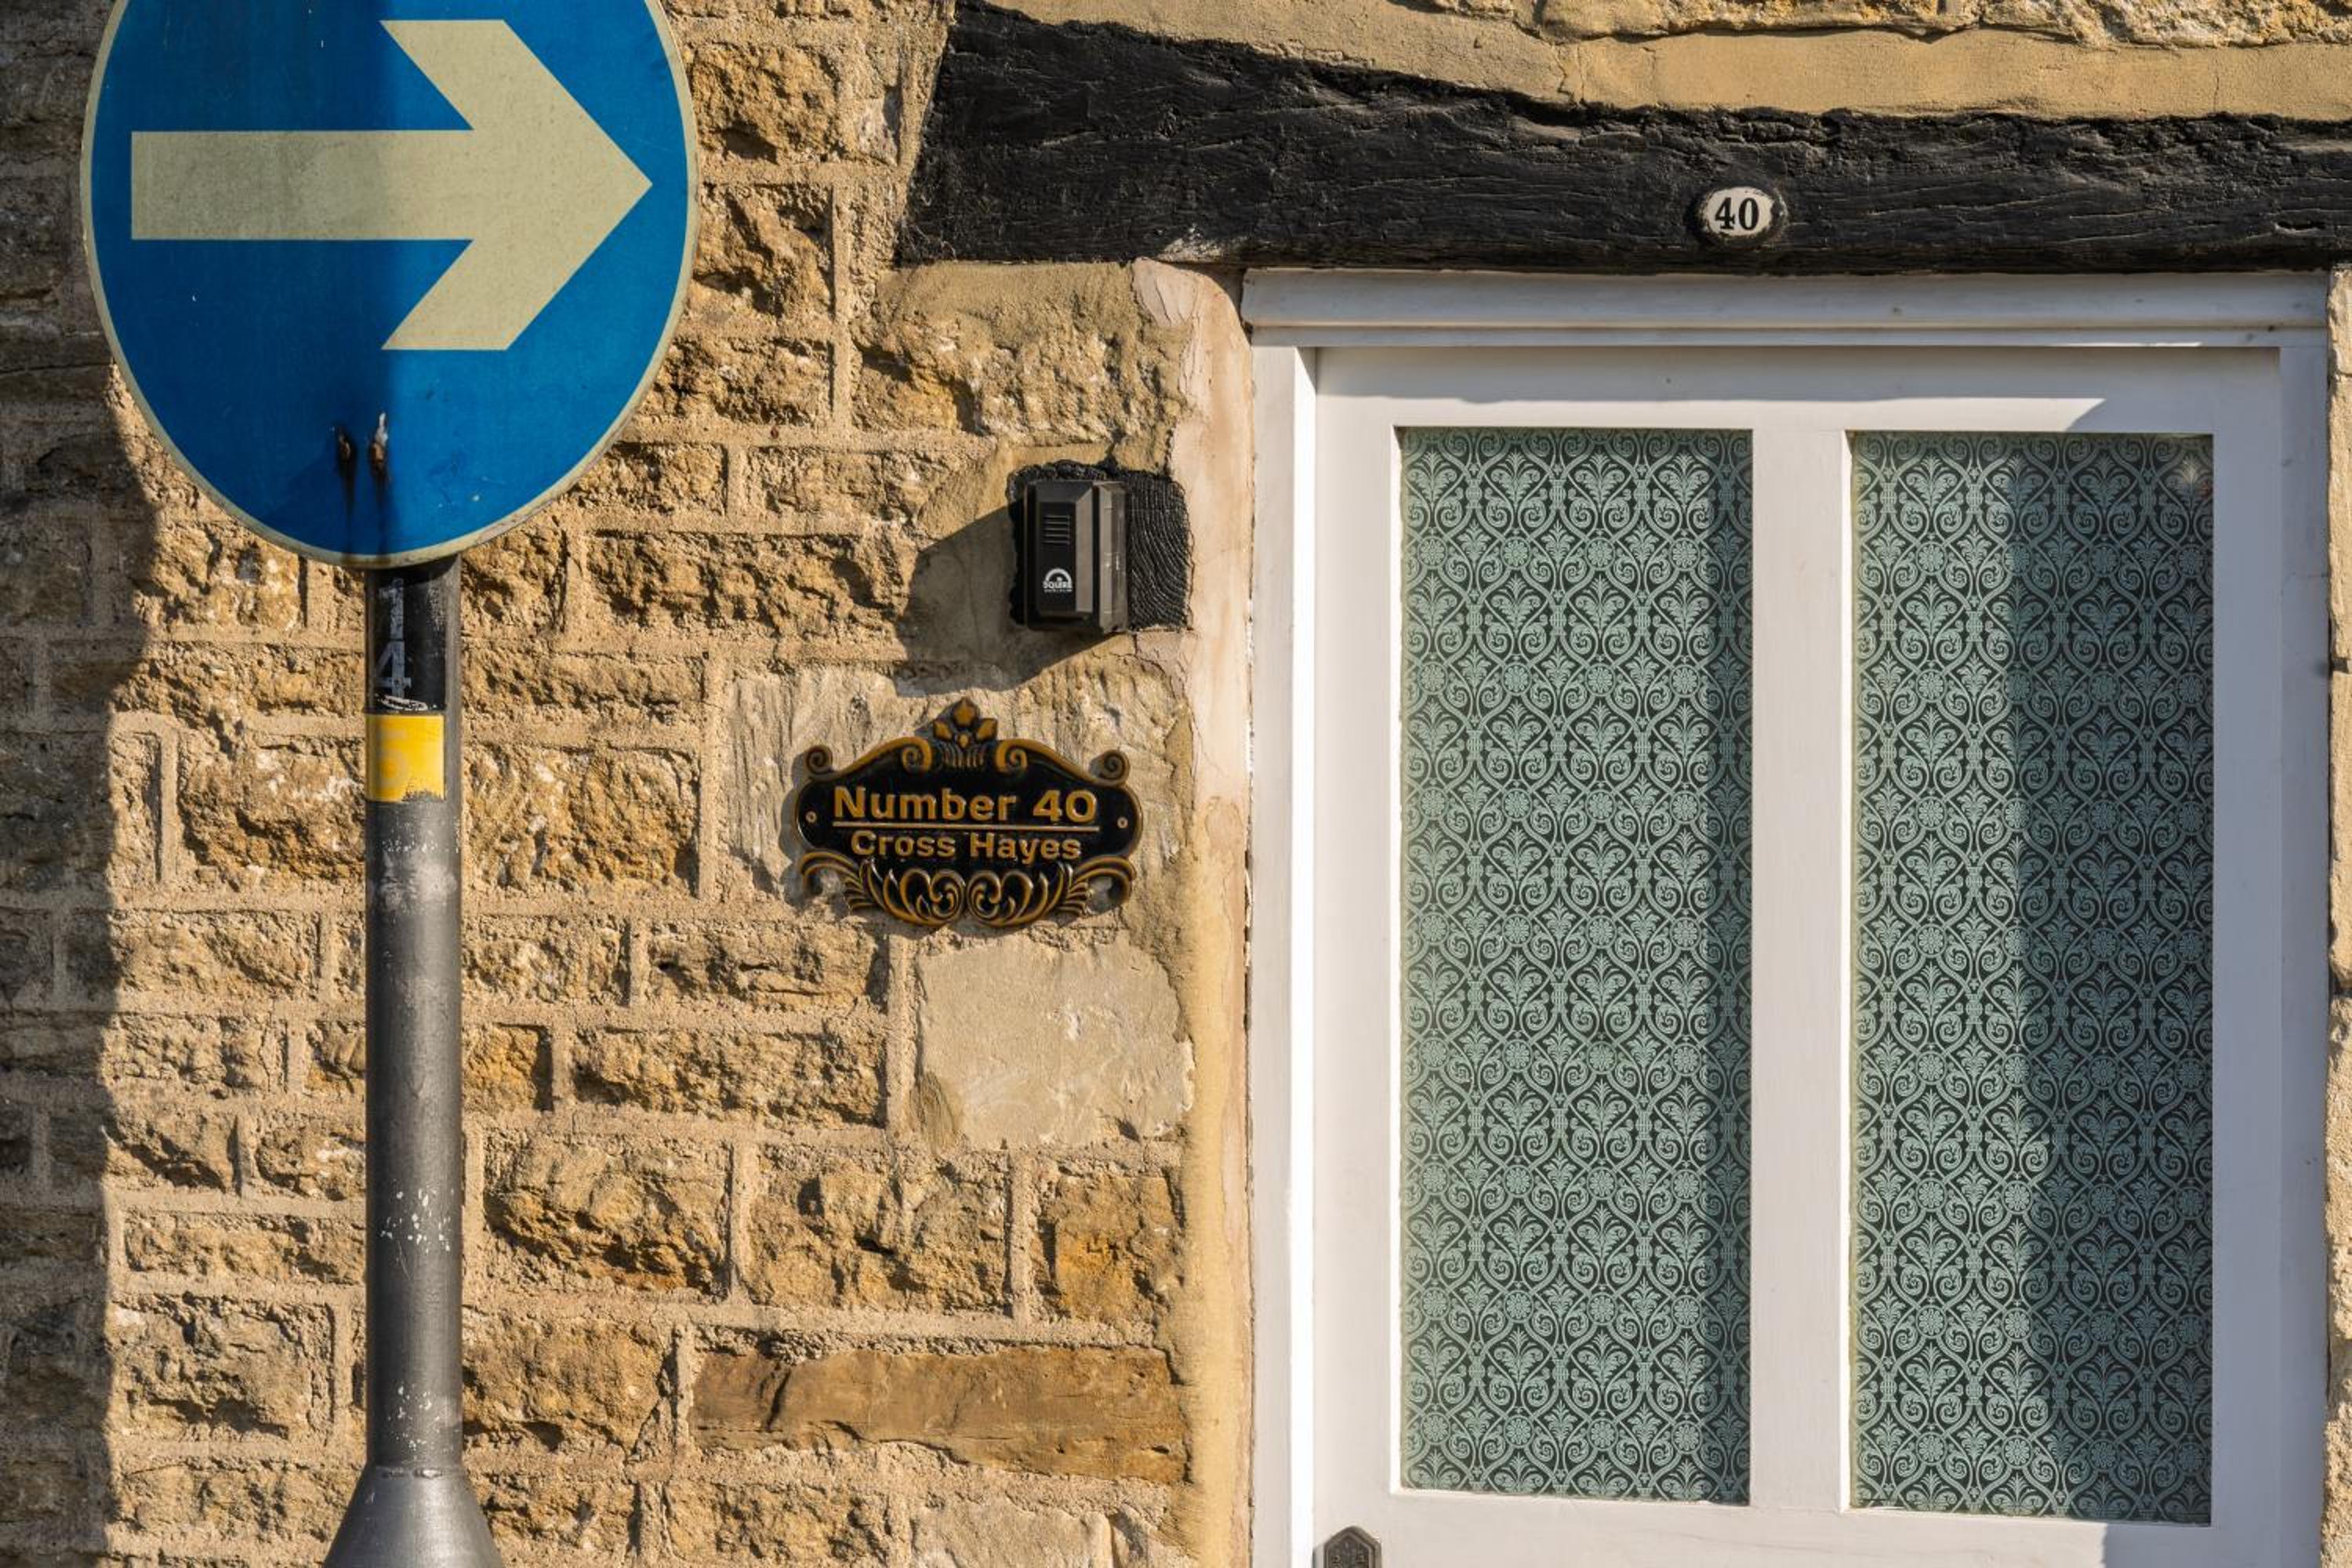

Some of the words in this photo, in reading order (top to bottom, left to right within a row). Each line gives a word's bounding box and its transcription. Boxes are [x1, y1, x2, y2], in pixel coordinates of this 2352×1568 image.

[1715, 197, 1759, 230] 40
[833, 785, 1018, 822] Number
[1032, 789, 1098, 823] 40
[851, 829, 955, 858] Cross
[969, 831, 1082, 864] Hayes
